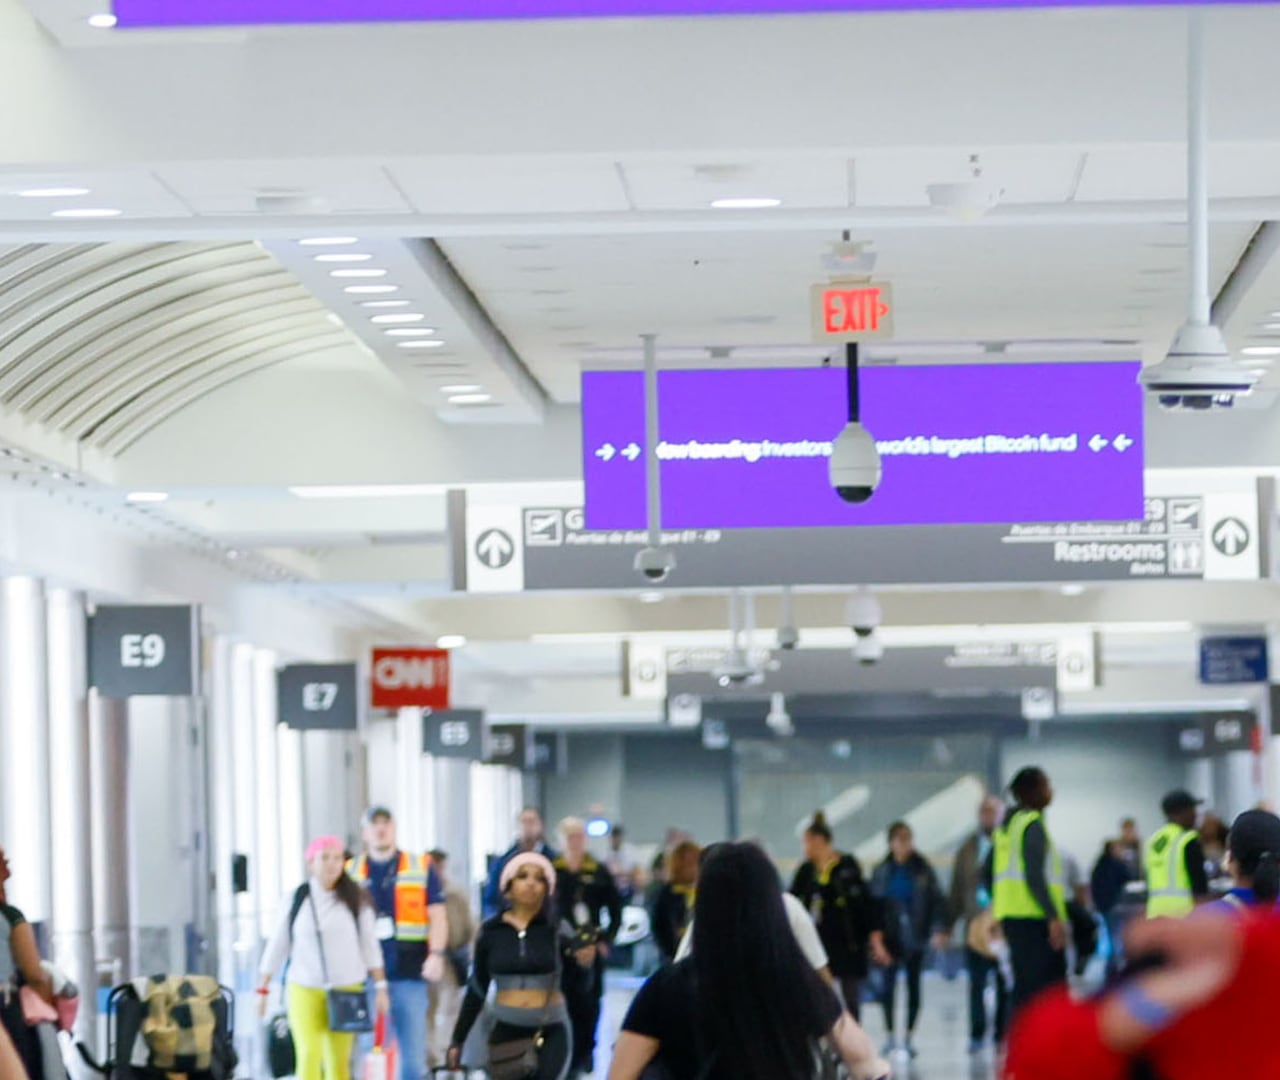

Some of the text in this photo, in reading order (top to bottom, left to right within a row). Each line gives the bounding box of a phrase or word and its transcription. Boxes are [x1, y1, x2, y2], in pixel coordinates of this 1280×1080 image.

[822, 287, 881, 333] EXIT
[689, 439, 761, 462] boarding
[762, 439, 832, 457] investors
[931, 436, 983, 458] largest
[984, 434, 1039, 453] Bitcoin
[1039, 433, 1078, 452] fund
[1054, 541, 1165, 562] Restrooms
[120, 634, 165, 667] E9
[375, 656, 435, 690] CNN
[302, 682, 338, 710] E7
